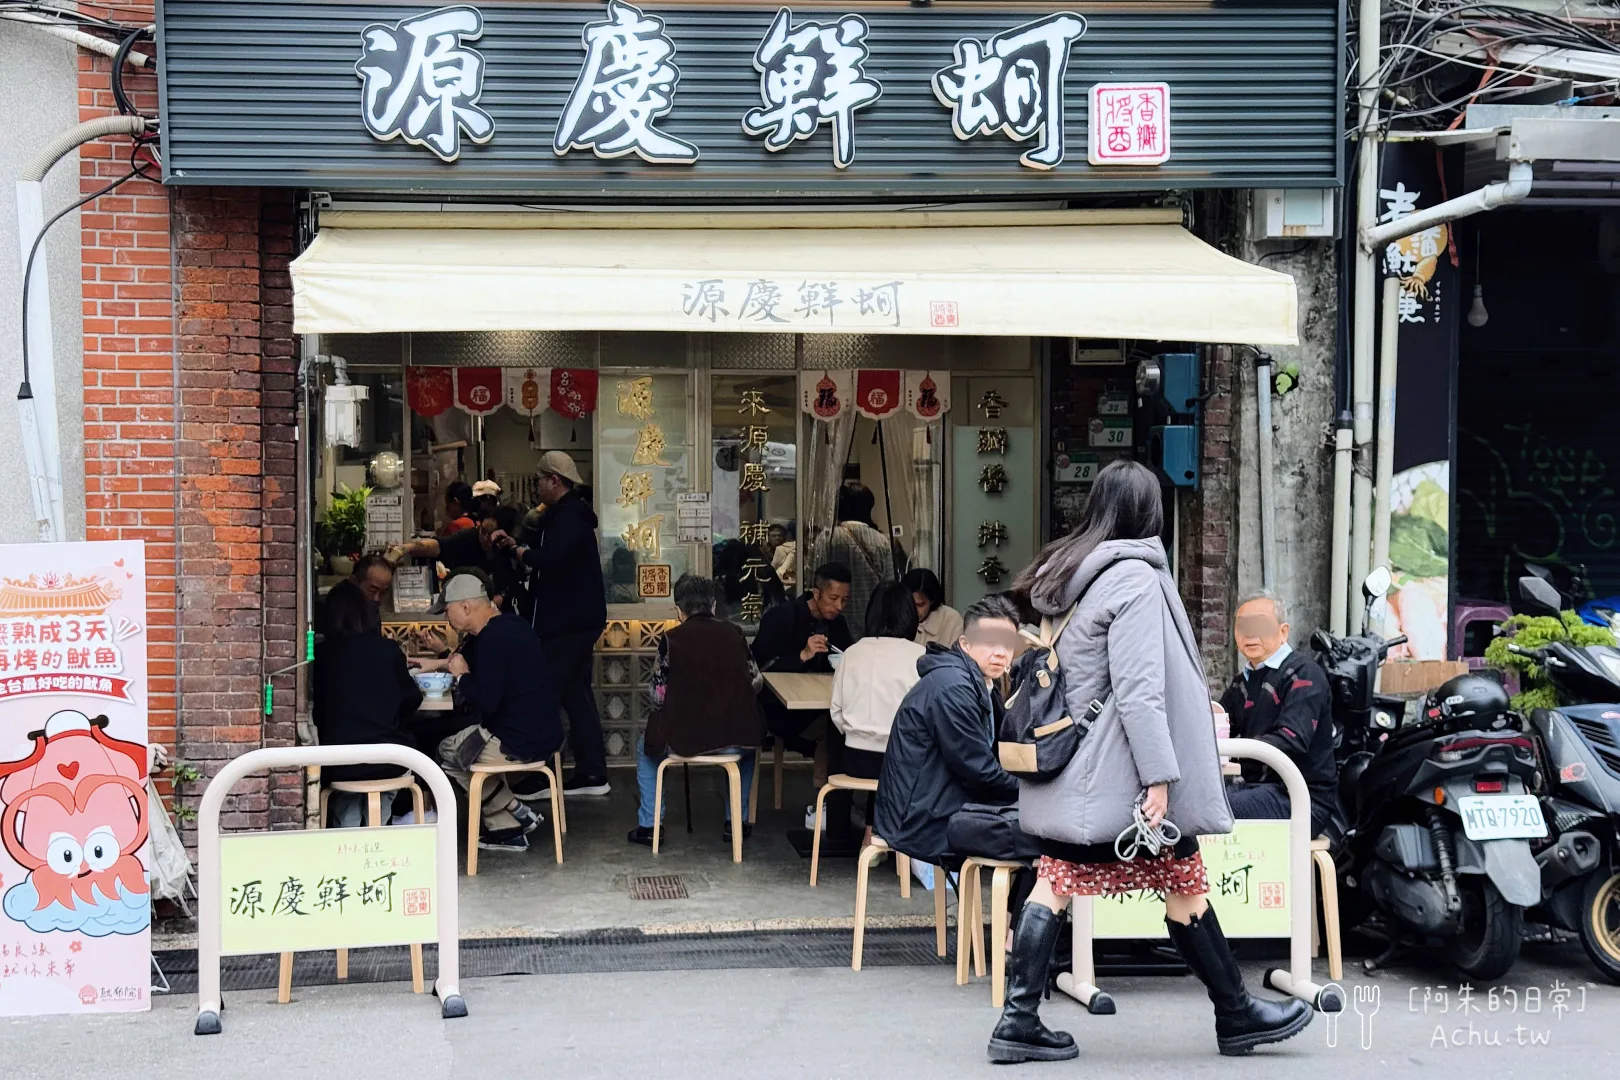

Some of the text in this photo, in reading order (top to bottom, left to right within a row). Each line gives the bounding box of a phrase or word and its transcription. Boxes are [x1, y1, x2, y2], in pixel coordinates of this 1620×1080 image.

[358, 2, 1086, 168] 源慶鮮蚵
[682, 278, 905, 327] 源慶鮮蚵
[472, 388, 489, 403] 福
[869, 391, 887, 405] 福
[1107, 430, 1124, 443] 30
[616, 376, 672, 560] 源慶鮮蚵
[1073, 465, 1090, 478] 28
[12, 620, 107, 645] 熟成3天
[230, 872, 398, 919] 源慶鮮蚵
